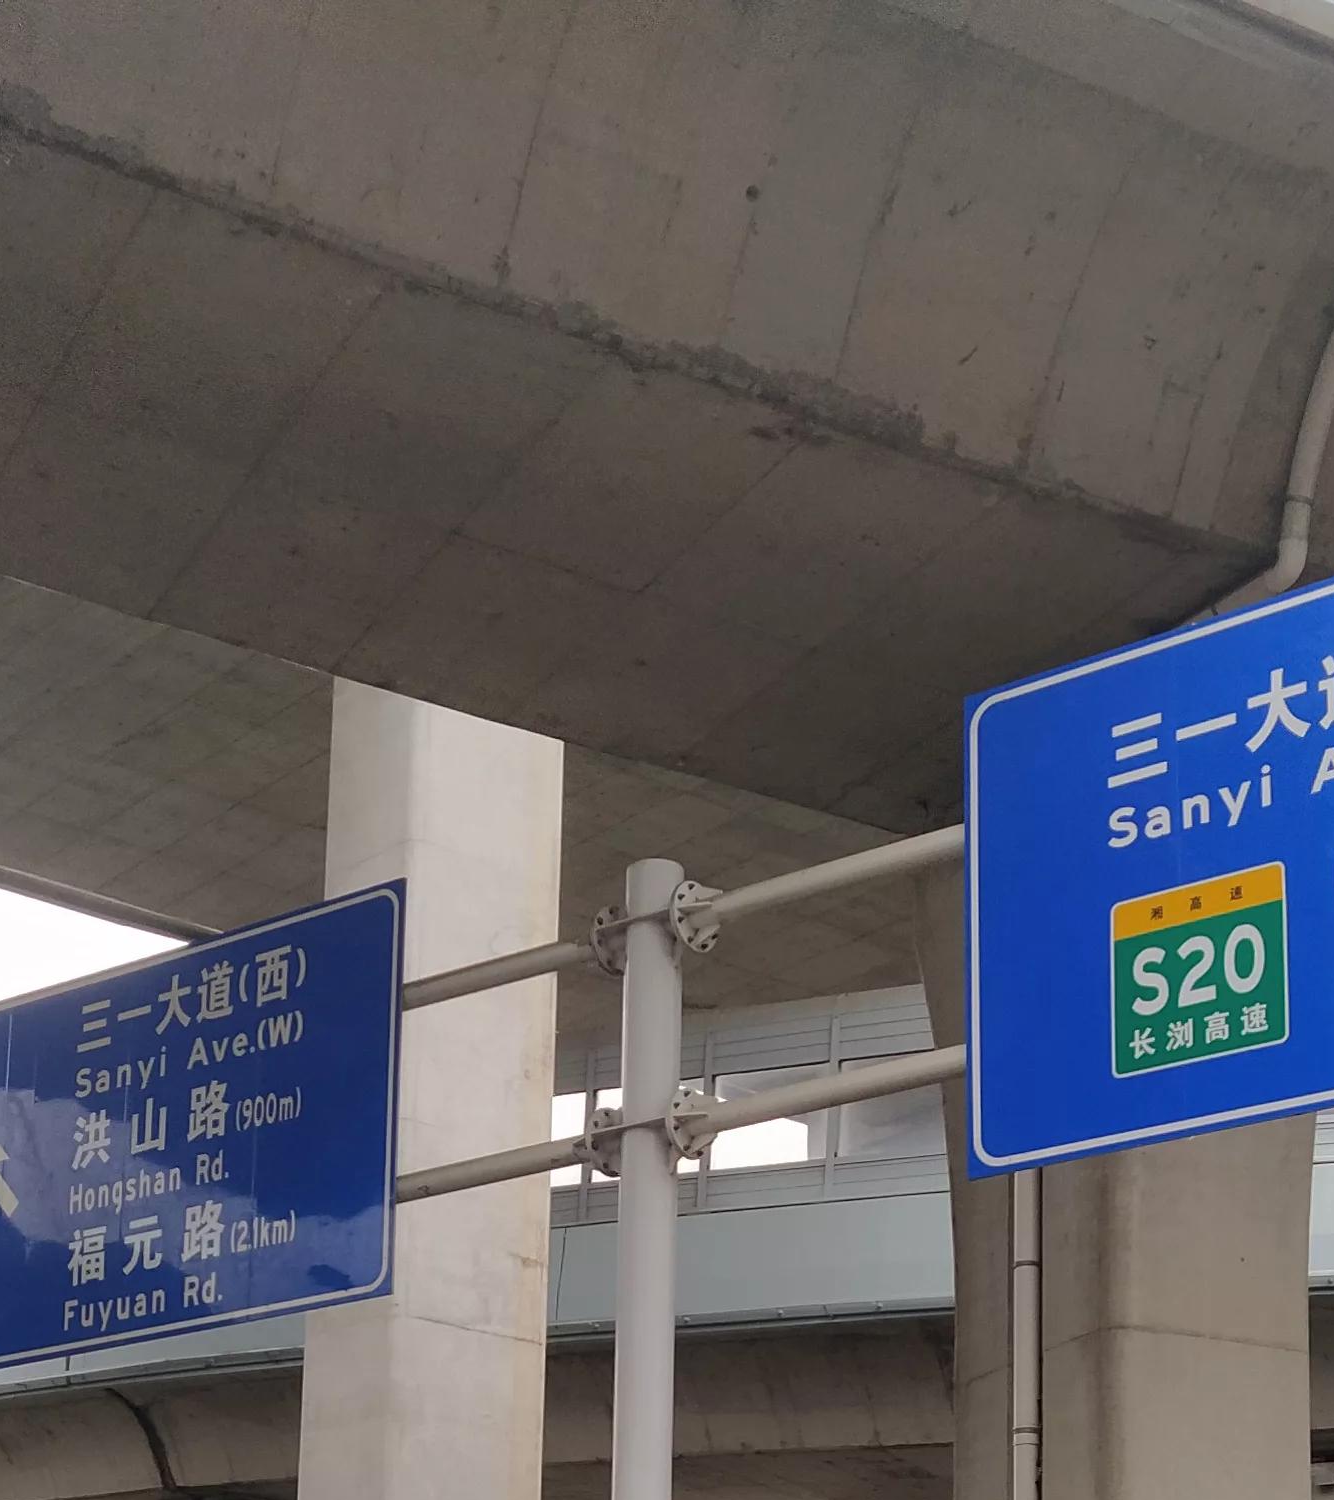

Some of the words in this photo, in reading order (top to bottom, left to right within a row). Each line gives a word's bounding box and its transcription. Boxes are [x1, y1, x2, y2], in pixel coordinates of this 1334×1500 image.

[1108, 765, 1273, 848] Sanyi
[1131, 924, 1266, 1017] S20
[75, 1046, 167, 1098] Sanyi
[186, 1011, 304, 1070] Ave.(W)
[1129, 1002, 1269, 1060] 长浏高速
[69, 1163, 181, 1215] Hongshan
[195, 1149, 230, 1184] Rd.
[63, 1287, 166, 1332] Fuyuan
[183, 1273, 224, 1307] Rd.
